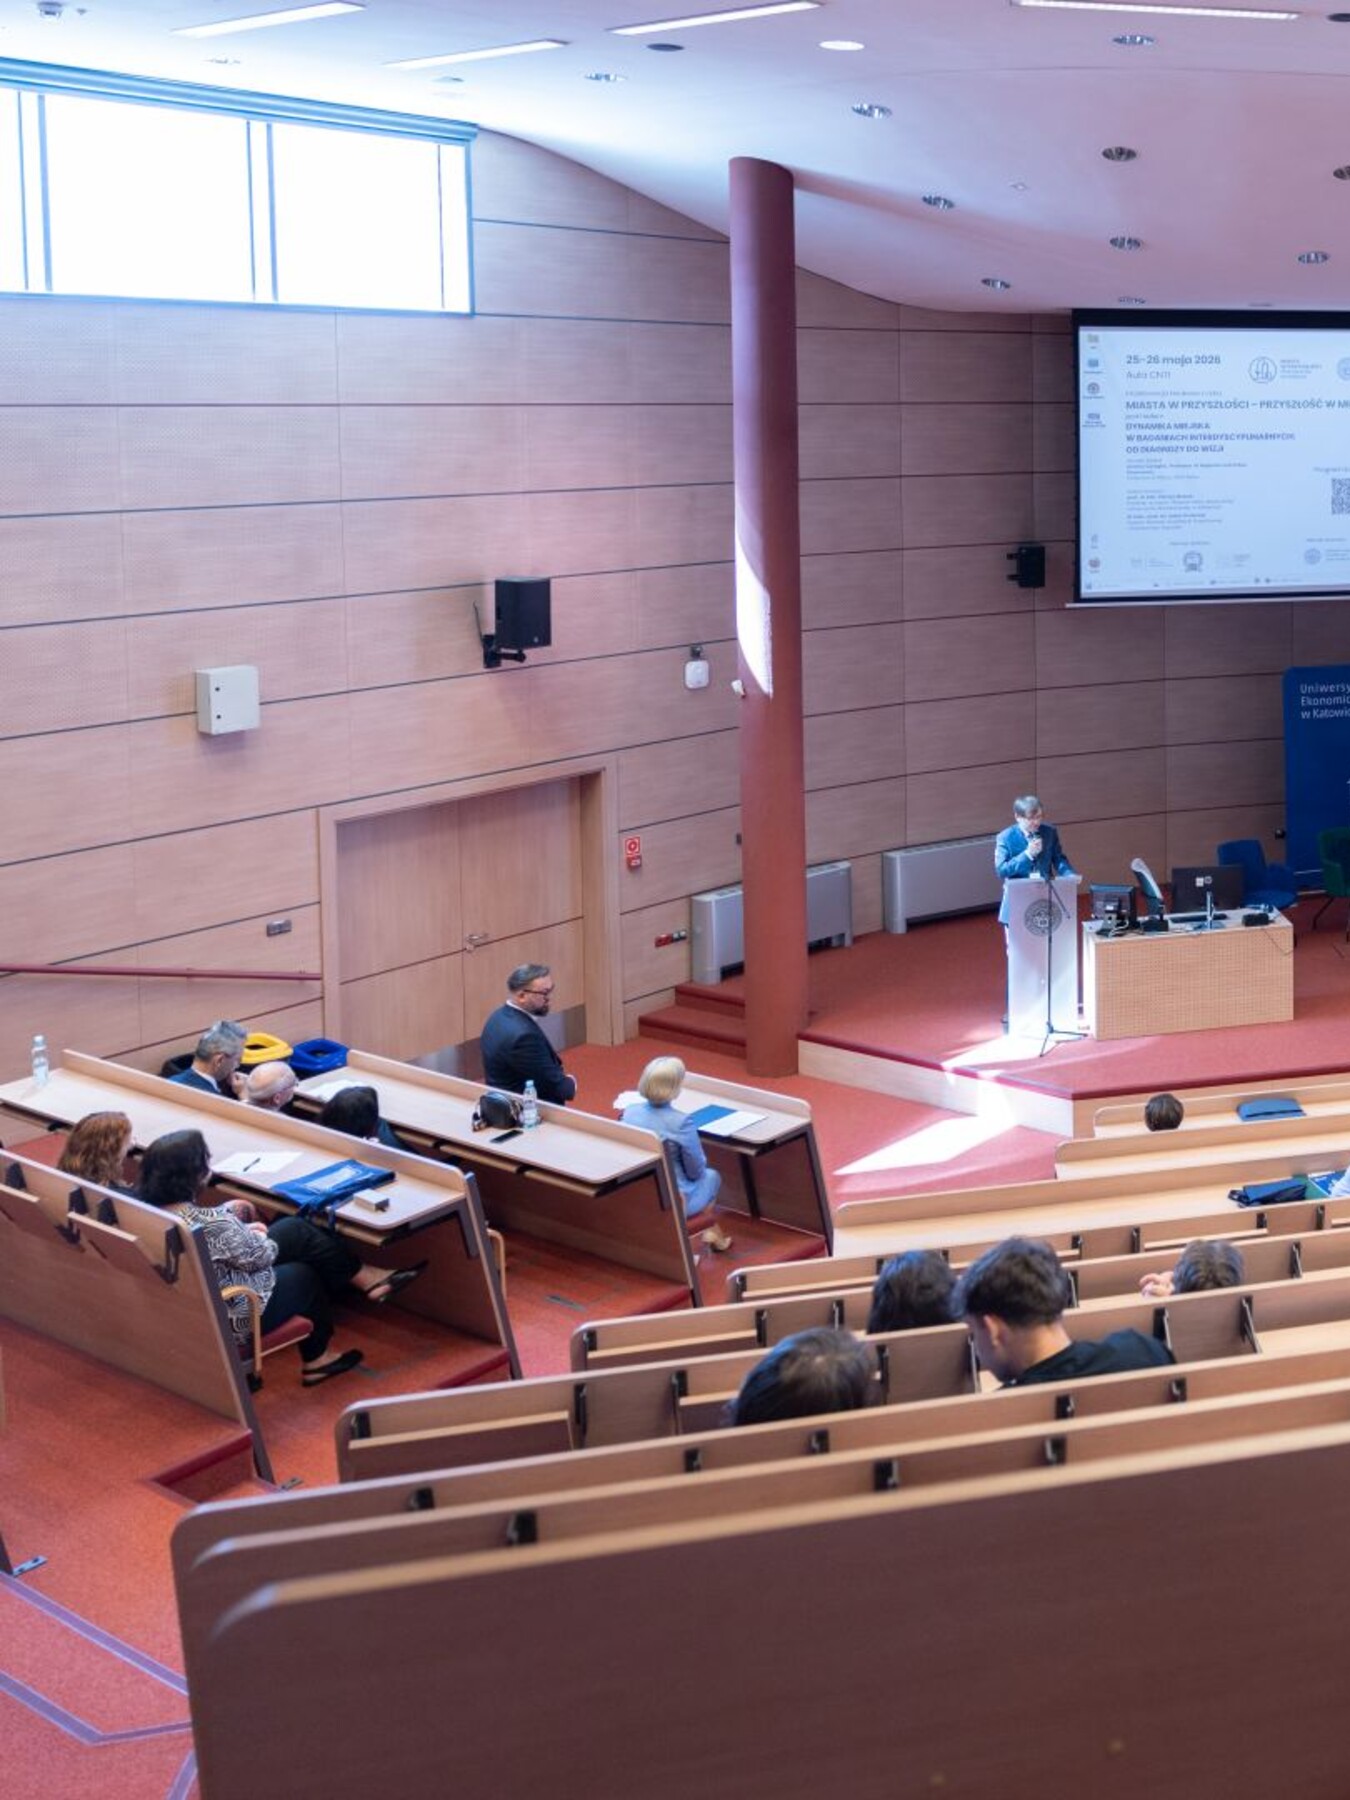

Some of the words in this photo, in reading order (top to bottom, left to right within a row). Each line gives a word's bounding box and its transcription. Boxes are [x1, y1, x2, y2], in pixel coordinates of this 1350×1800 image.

[1162, 354, 1193, 367] maja
[1126, 400, 1166, 409] MIASTA
[1168, 400, 1180, 409] W
[1181, 398, 1250, 409] PRZYSZŁOŚCI
[1260, 397, 1323, 409] PRZYSZŁOŚĆ
[1325, 400, 1336, 408] W
[1301, 710, 1311, 719] w
